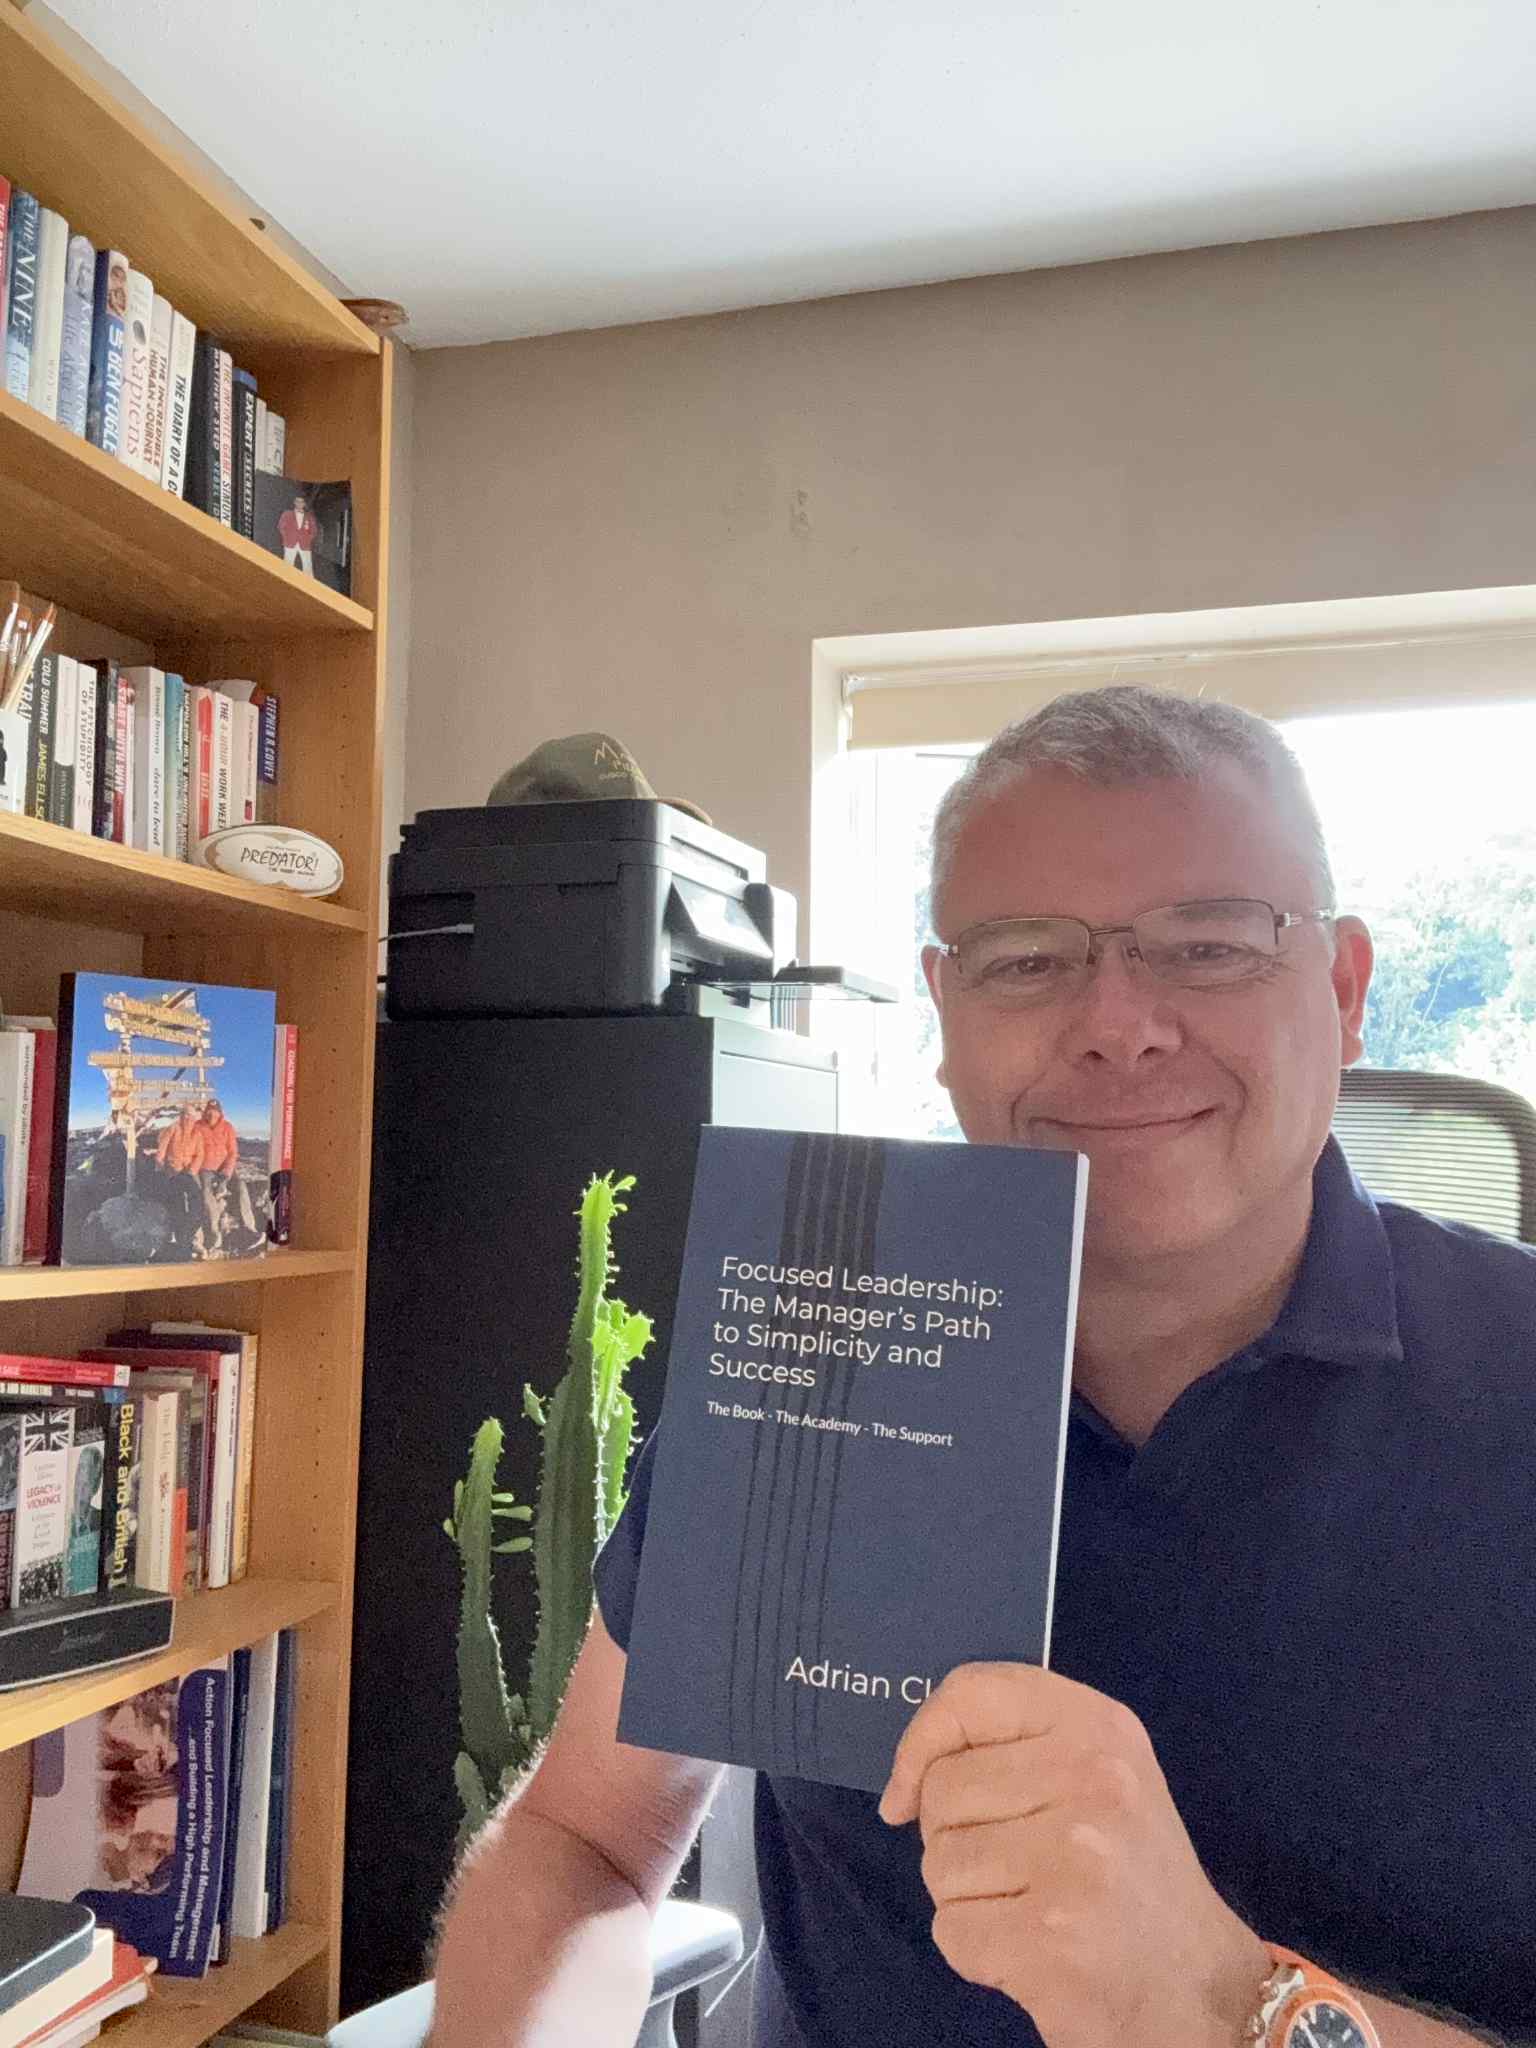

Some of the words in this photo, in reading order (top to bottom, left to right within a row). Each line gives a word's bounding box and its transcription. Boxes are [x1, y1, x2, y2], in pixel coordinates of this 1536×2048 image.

[13, 243, 36, 334] NINE
[105, 349, 123, 394] BEN
[147, 348, 160, 401] HUMAN
[158, 355, 168, 381] THE
[174, 373, 187, 401] THE
[102, 389, 121, 455] FOGLE
[123, 347, 147, 456] Sapiens
[244, 391, 255, 452] EXPERT
[143, 402, 156, 465] JOURNEY
[153, 384, 166, 469] INCREDIBLE
[171, 402, 185, 445] DIARY
[168, 466, 179, 479] A
[169, 445, 181, 470] OF
[221, 479, 232, 522] SIMON
[41, 657, 52, 687] COLD
[87, 680, 96, 703] THE
[39, 687, 51, 735] SUMMER
[80, 689, 88, 705] OF
[117, 686, 128, 726] START
[219, 701, 229, 722] THE
[265, 695, 278, 738] STEPHEN
[37, 738, 48, 783] JAMES
[79, 708, 88, 773] STUPIDITY
[85, 705, 95, 786] PSYCHOLOGY
[116, 728, 127, 762] WITH
[114, 763, 126, 794] WHY
[218, 767, 227, 800] WORK
[263, 746, 275, 781] COVEY
[240, 847, 319, 871] PREDATOR!
[285, 1049, 296, 1088] COACHING
[721, 1256, 834, 1289] Focused
[842, 1268, 1004, 1311] Leadership:
[717, 1287, 766, 1314] The
[773, 1294, 917, 1331] Manager's
[925, 1310, 991, 1341] Path
[713, 1321, 740, 1345] to
[746, 1323, 881, 1366] Simplicity
[887, 1344, 943, 1368] and
[708, 1352, 817, 1387] Success
[119, 1403, 135, 1460] Black
[706, 1400, 731, 1417] The
[732, 1404, 765, 1421] Book
[775, 1409, 800, 1427] The
[801, 1413, 862, 1436] Academy
[871, 1421, 897, 1440] The
[898, 1426, 953, 1448] Support
[26, 1485, 55, 1499] LEGACY
[26, 1495, 62, 1511] VIOLENCE
[116, 1466, 132, 1505] and
[112, 1508, 130, 1573] British
[204, 1676, 216, 1717] Action
[784, 1655, 890, 1700] Adrian
[203, 1719, 215, 1773] Focused
[186, 1762, 198, 1810] Building
[201, 1774, 214, 1844] Leadership
[184, 1821, 197, 1851] High
[199, 1847, 211, 1872] and
[175, 1852, 195, 1922] Performing
[185, 1874, 209, 1961] Management
[168, 1923, 185, 1959] Team
